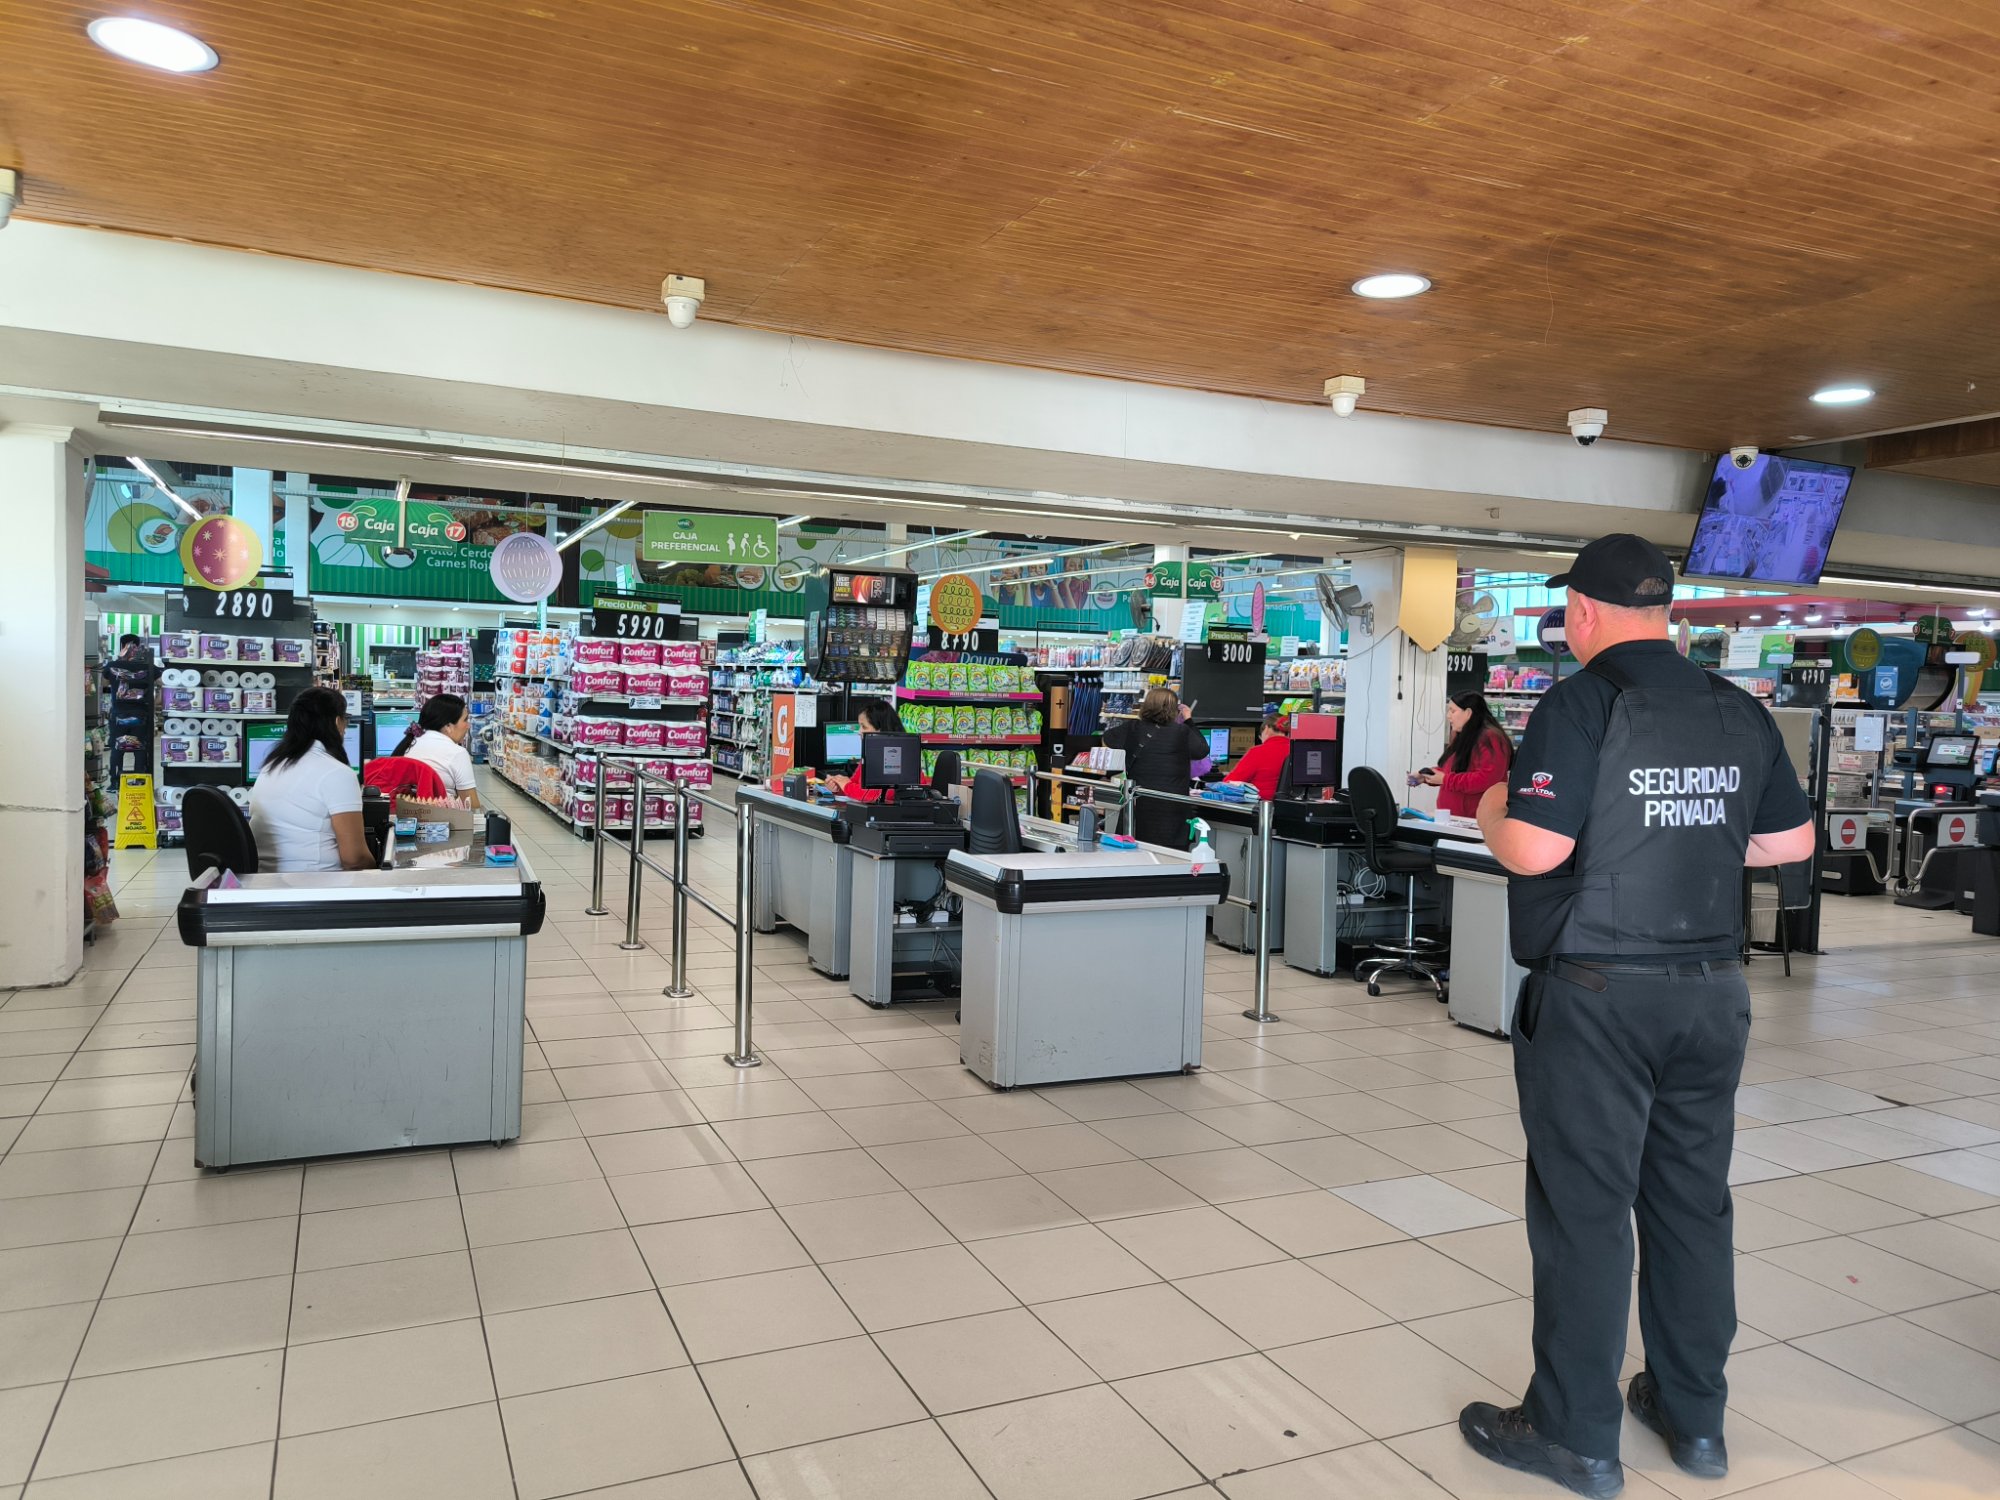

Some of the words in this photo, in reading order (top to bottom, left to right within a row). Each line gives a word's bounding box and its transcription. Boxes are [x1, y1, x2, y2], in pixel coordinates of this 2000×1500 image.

[338, 516, 356, 529] 18
[364, 518, 395, 534] Caja
[408, 523, 439, 538] Caja
[447, 526, 463, 539] 17
[672, 531, 698, 541] CAJA
[651, 541, 720, 553] PREFERENCIAL
[426, 556, 467, 569] Carnes
[470, 559, 492, 572] Roj
[1144, 576, 1154, 585] 14
[1160, 577, 1180, 589] Caja
[1187, 578, 1207, 590] Caja
[1212, 579, 1221, 588] 13
[216, 592, 273, 617] 2890
[597, 599, 625, 609] Precio
[617, 613, 665, 639] 5990
[172, 638, 189, 646] Elite
[210, 640, 228, 648] Elite
[244, 642, 262, 651] Elite
[284, 643, 301, 652] Elite
[580, 645, 615, 656] Confort
[622, 646, 657, 657] Confort
[664, 647, 698, 658] Confort
[1222, 643, 1253, 663] 3000
[1447, 654, 1474, 672] 2990
[585, 675, 620, 685] Confort
[627, 677, 662, 687] Confort
[1801, 669, 1825, 685] 4790
[671, 679, 705, 689] Confort
[176, 692, 193, 701] Elite
[214, 693, 232, 701] Elite
[777, 704, 788, 744] G
[585, 725, 620, 736] Confort
[627, 727, 661, 738] Confort
[668, 730, 702, 740] Confort
[170, 742, 188, 750] Elite
[207, 742, 225, 750] Elite
[675, 766, 709, 777] Confort
[1628, 766, 1741, 796] SEGURIDAD
[164, 810, 182, 818] Elite
[1644, 798, 1727, 827] PRIVADA
